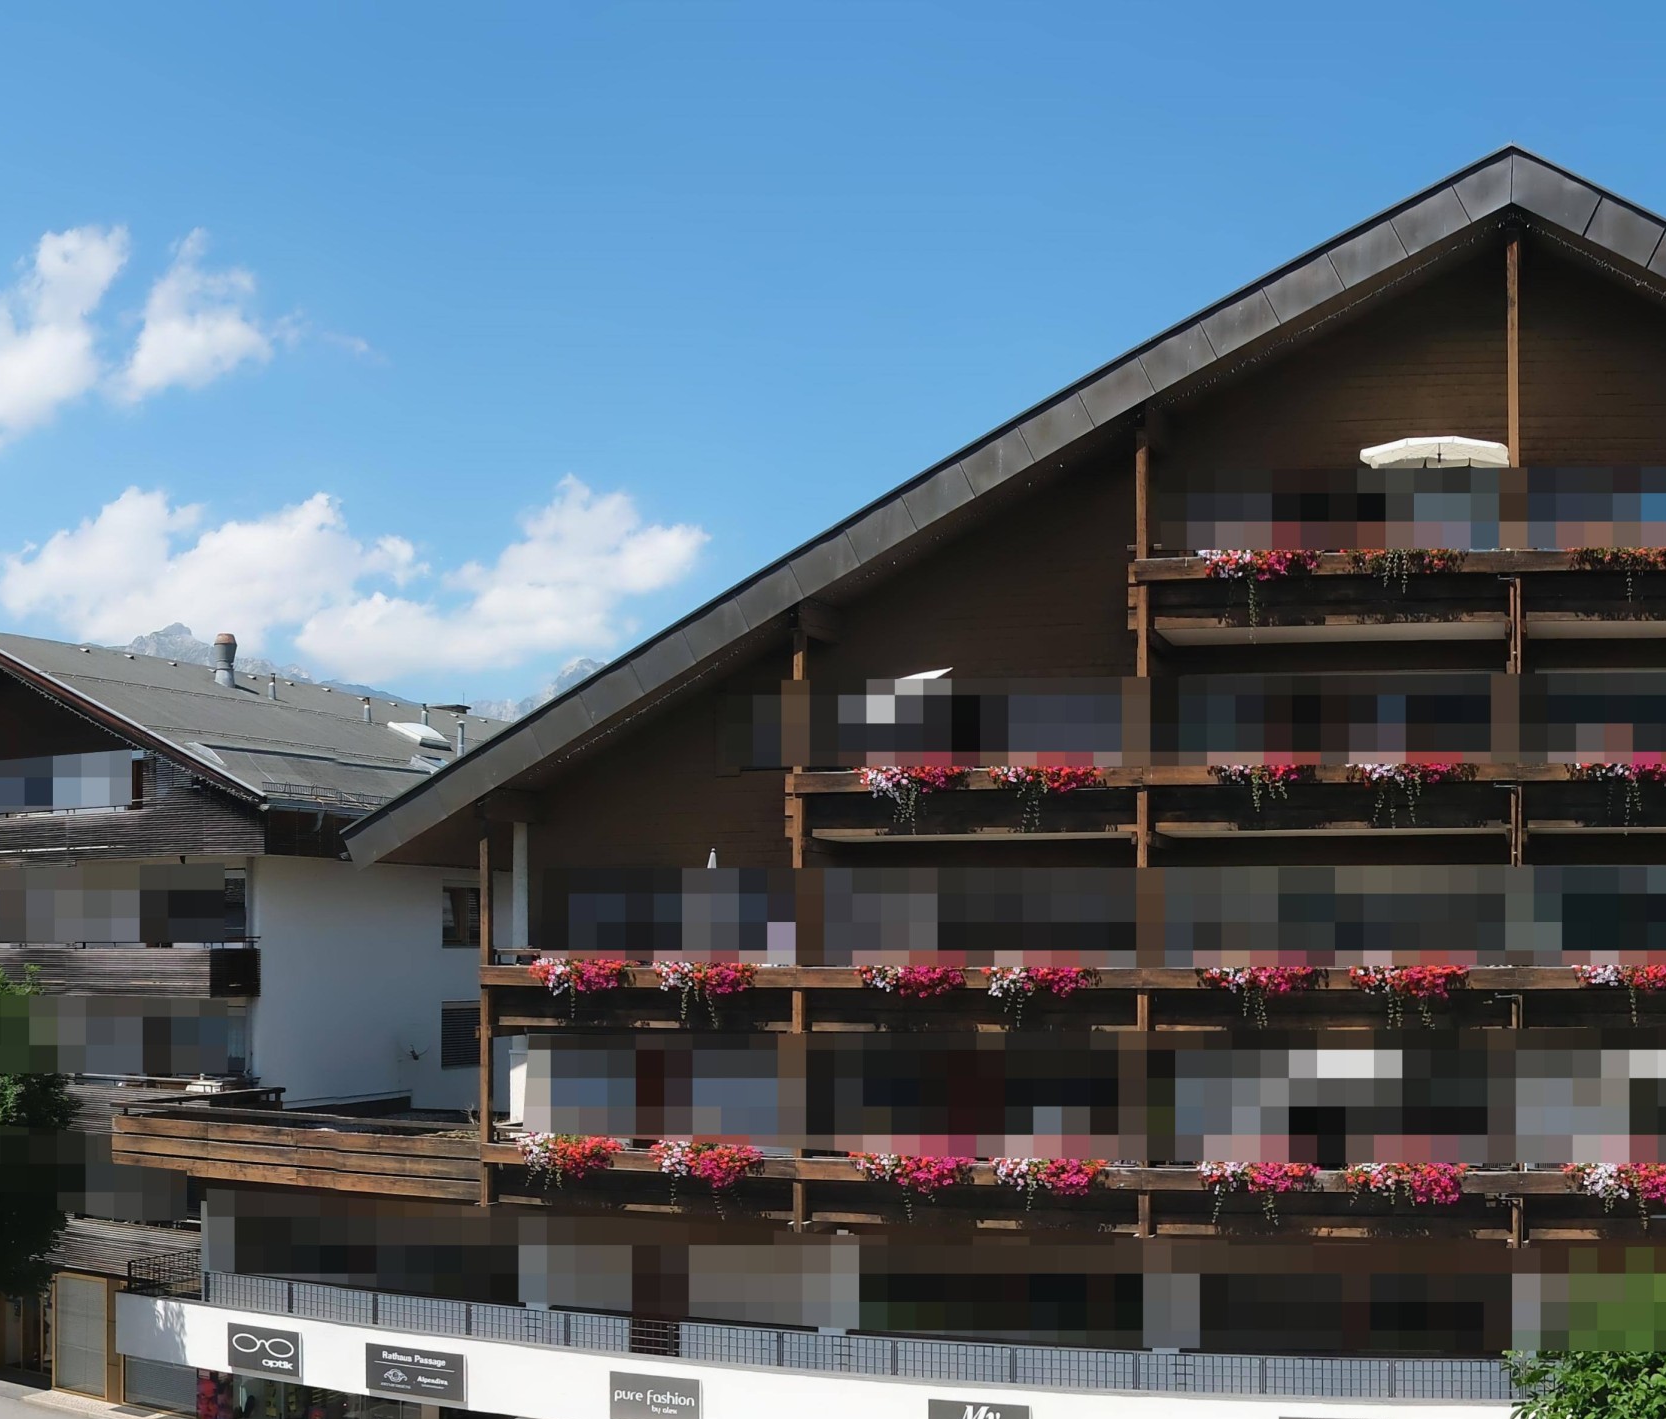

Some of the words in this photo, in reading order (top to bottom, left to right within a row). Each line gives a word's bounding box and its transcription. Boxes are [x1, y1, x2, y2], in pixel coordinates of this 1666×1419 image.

[262, 1358, 294, 1370] optik
[382, 1350, 413, 1363] Rathaus
[414, 1355, 446, 1367] Passage
[614, 1389, 644, 1402] pure
[646, 1389, 695, 1407] fashion
[651, 1405, 661, 1414] by
[662, 1406, 678, 1415] alex
